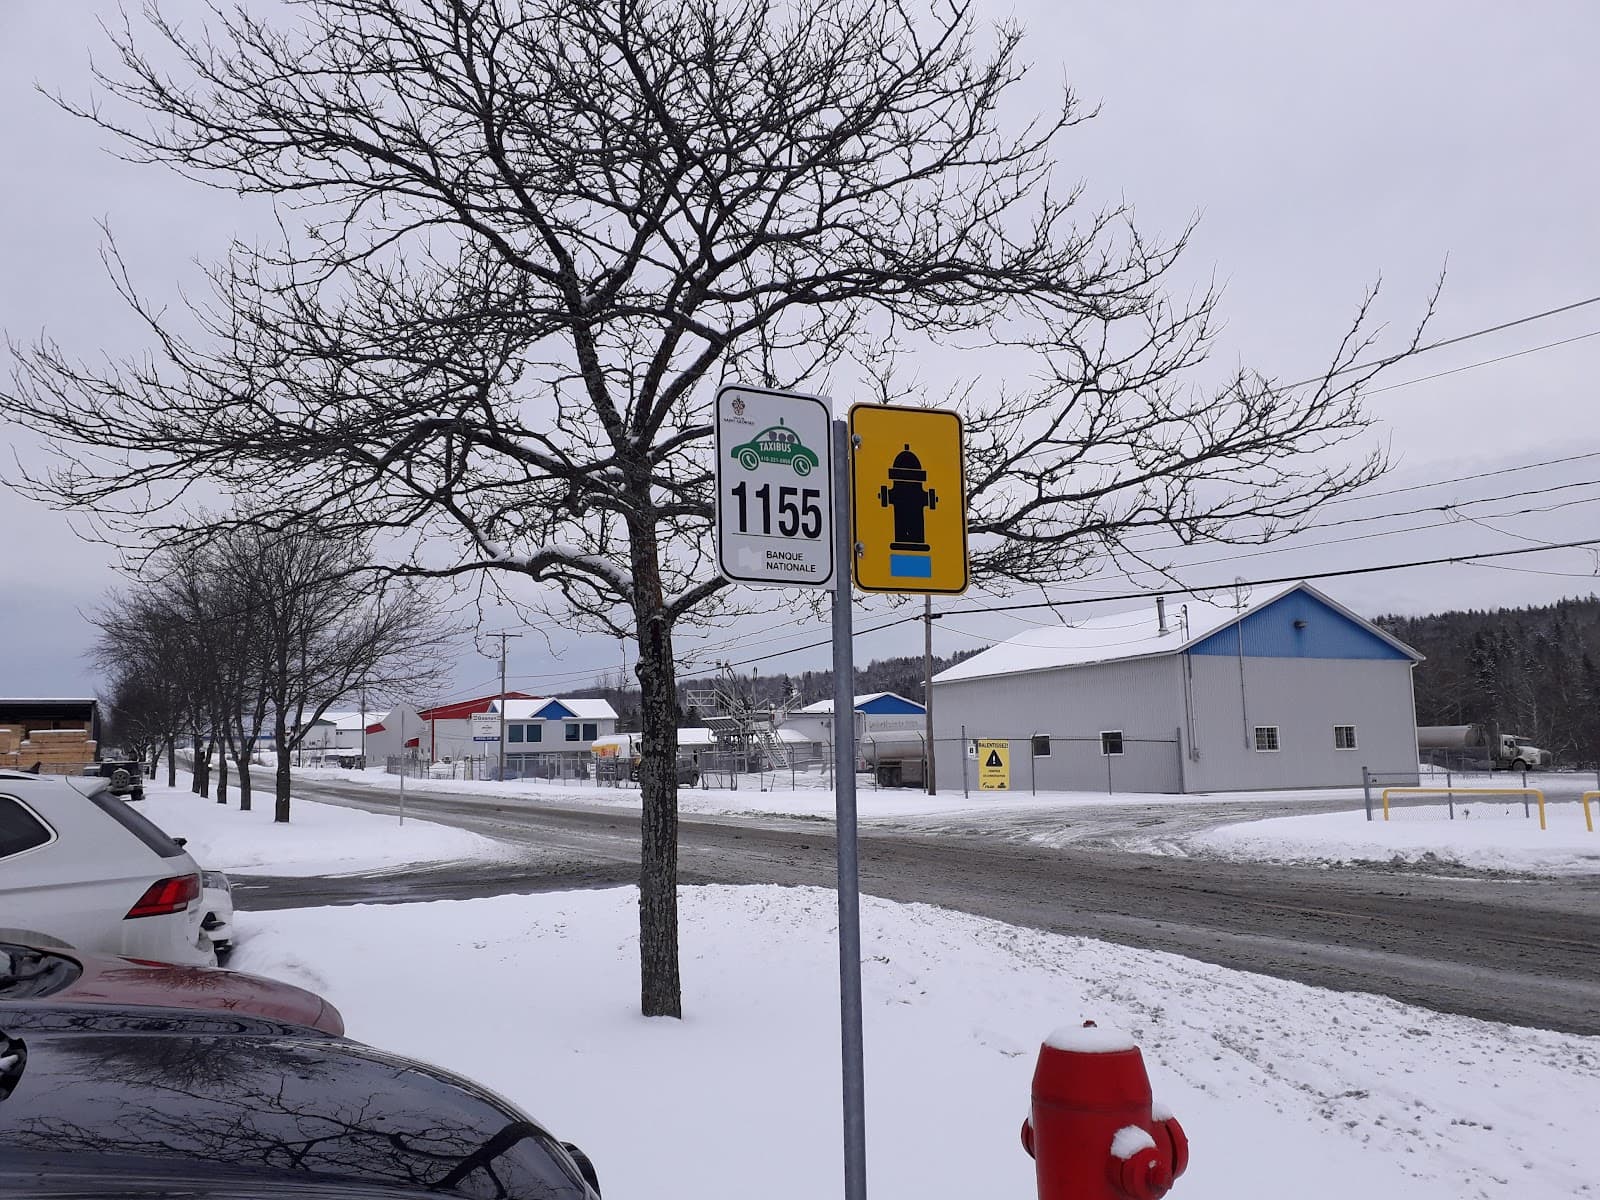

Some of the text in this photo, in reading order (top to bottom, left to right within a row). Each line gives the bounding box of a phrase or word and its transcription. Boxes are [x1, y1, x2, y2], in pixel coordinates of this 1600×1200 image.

[759, 441, 792, 453] TAXIBUS
[731, 481, 822, 539] 1155
[766, 550, 804, 561] BANQUE
[766, 561, 817, 573] NATIONALE
